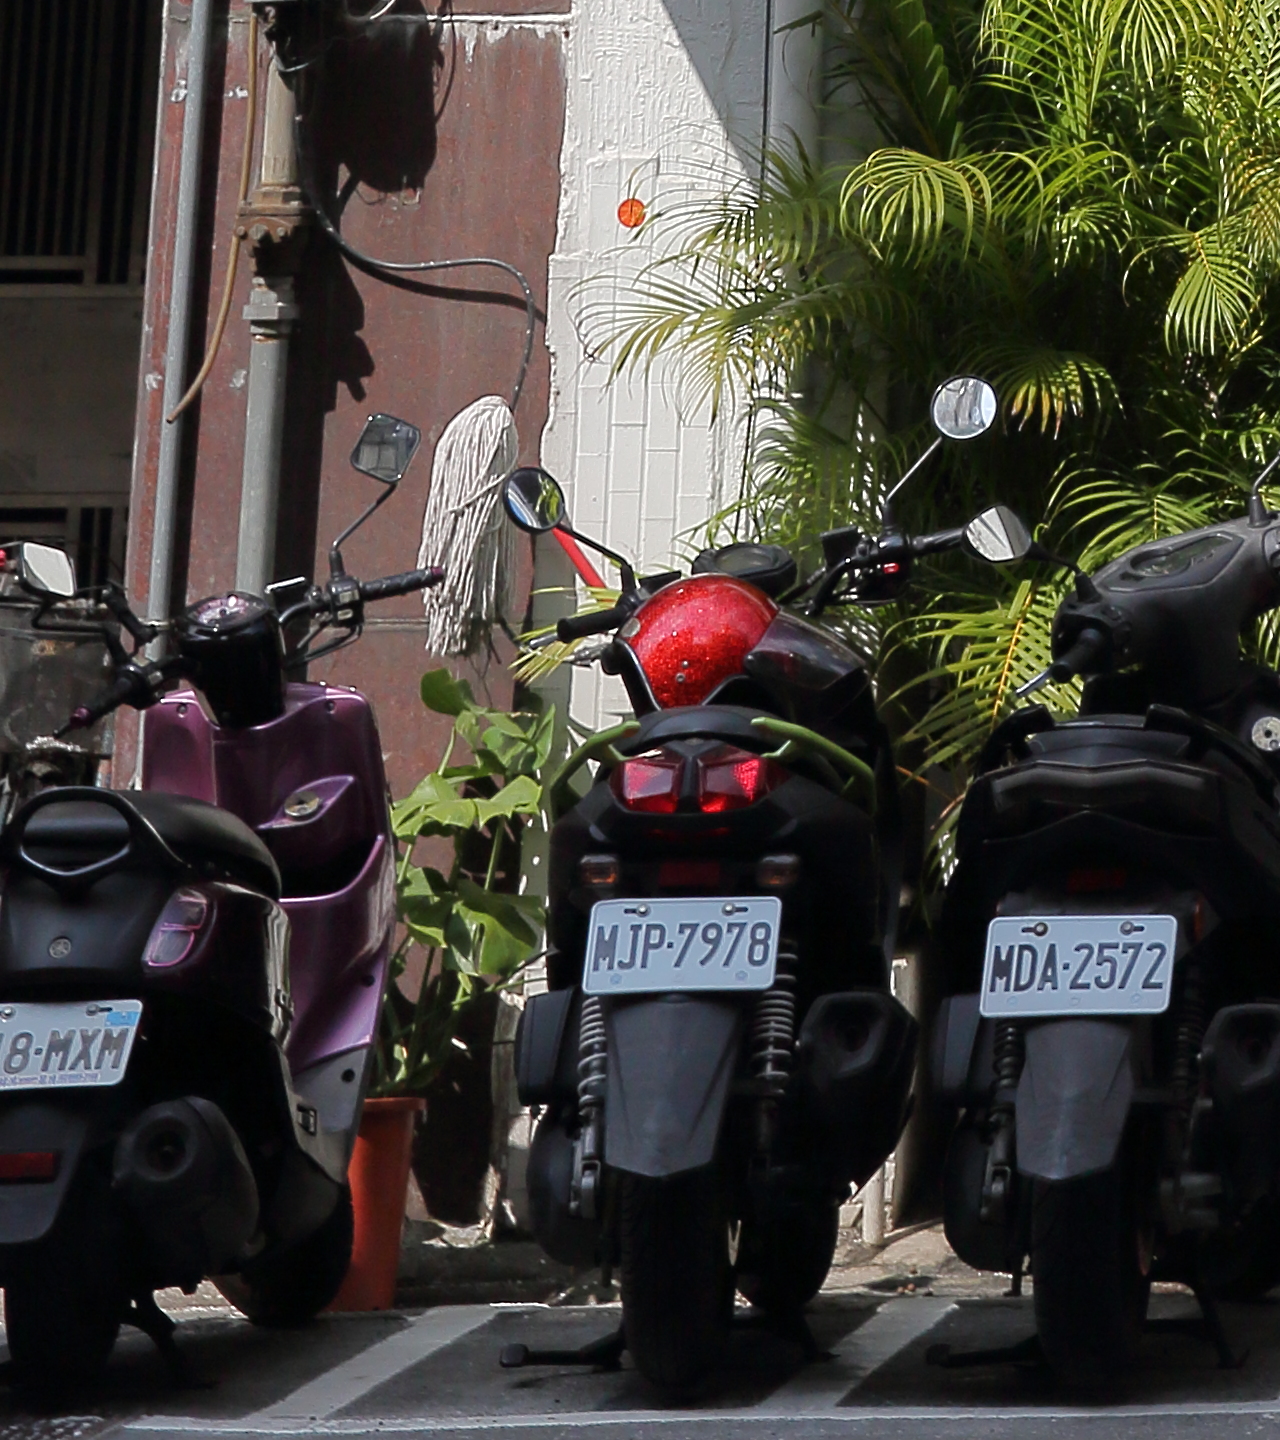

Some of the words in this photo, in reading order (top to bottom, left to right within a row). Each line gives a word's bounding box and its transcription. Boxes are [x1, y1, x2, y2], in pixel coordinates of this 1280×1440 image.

[592, 921, 772, 972] MJP-7978
[989, 942, 1167, 993] MDA-2572
[0, 1027, 129, 1075] 8-MXM
